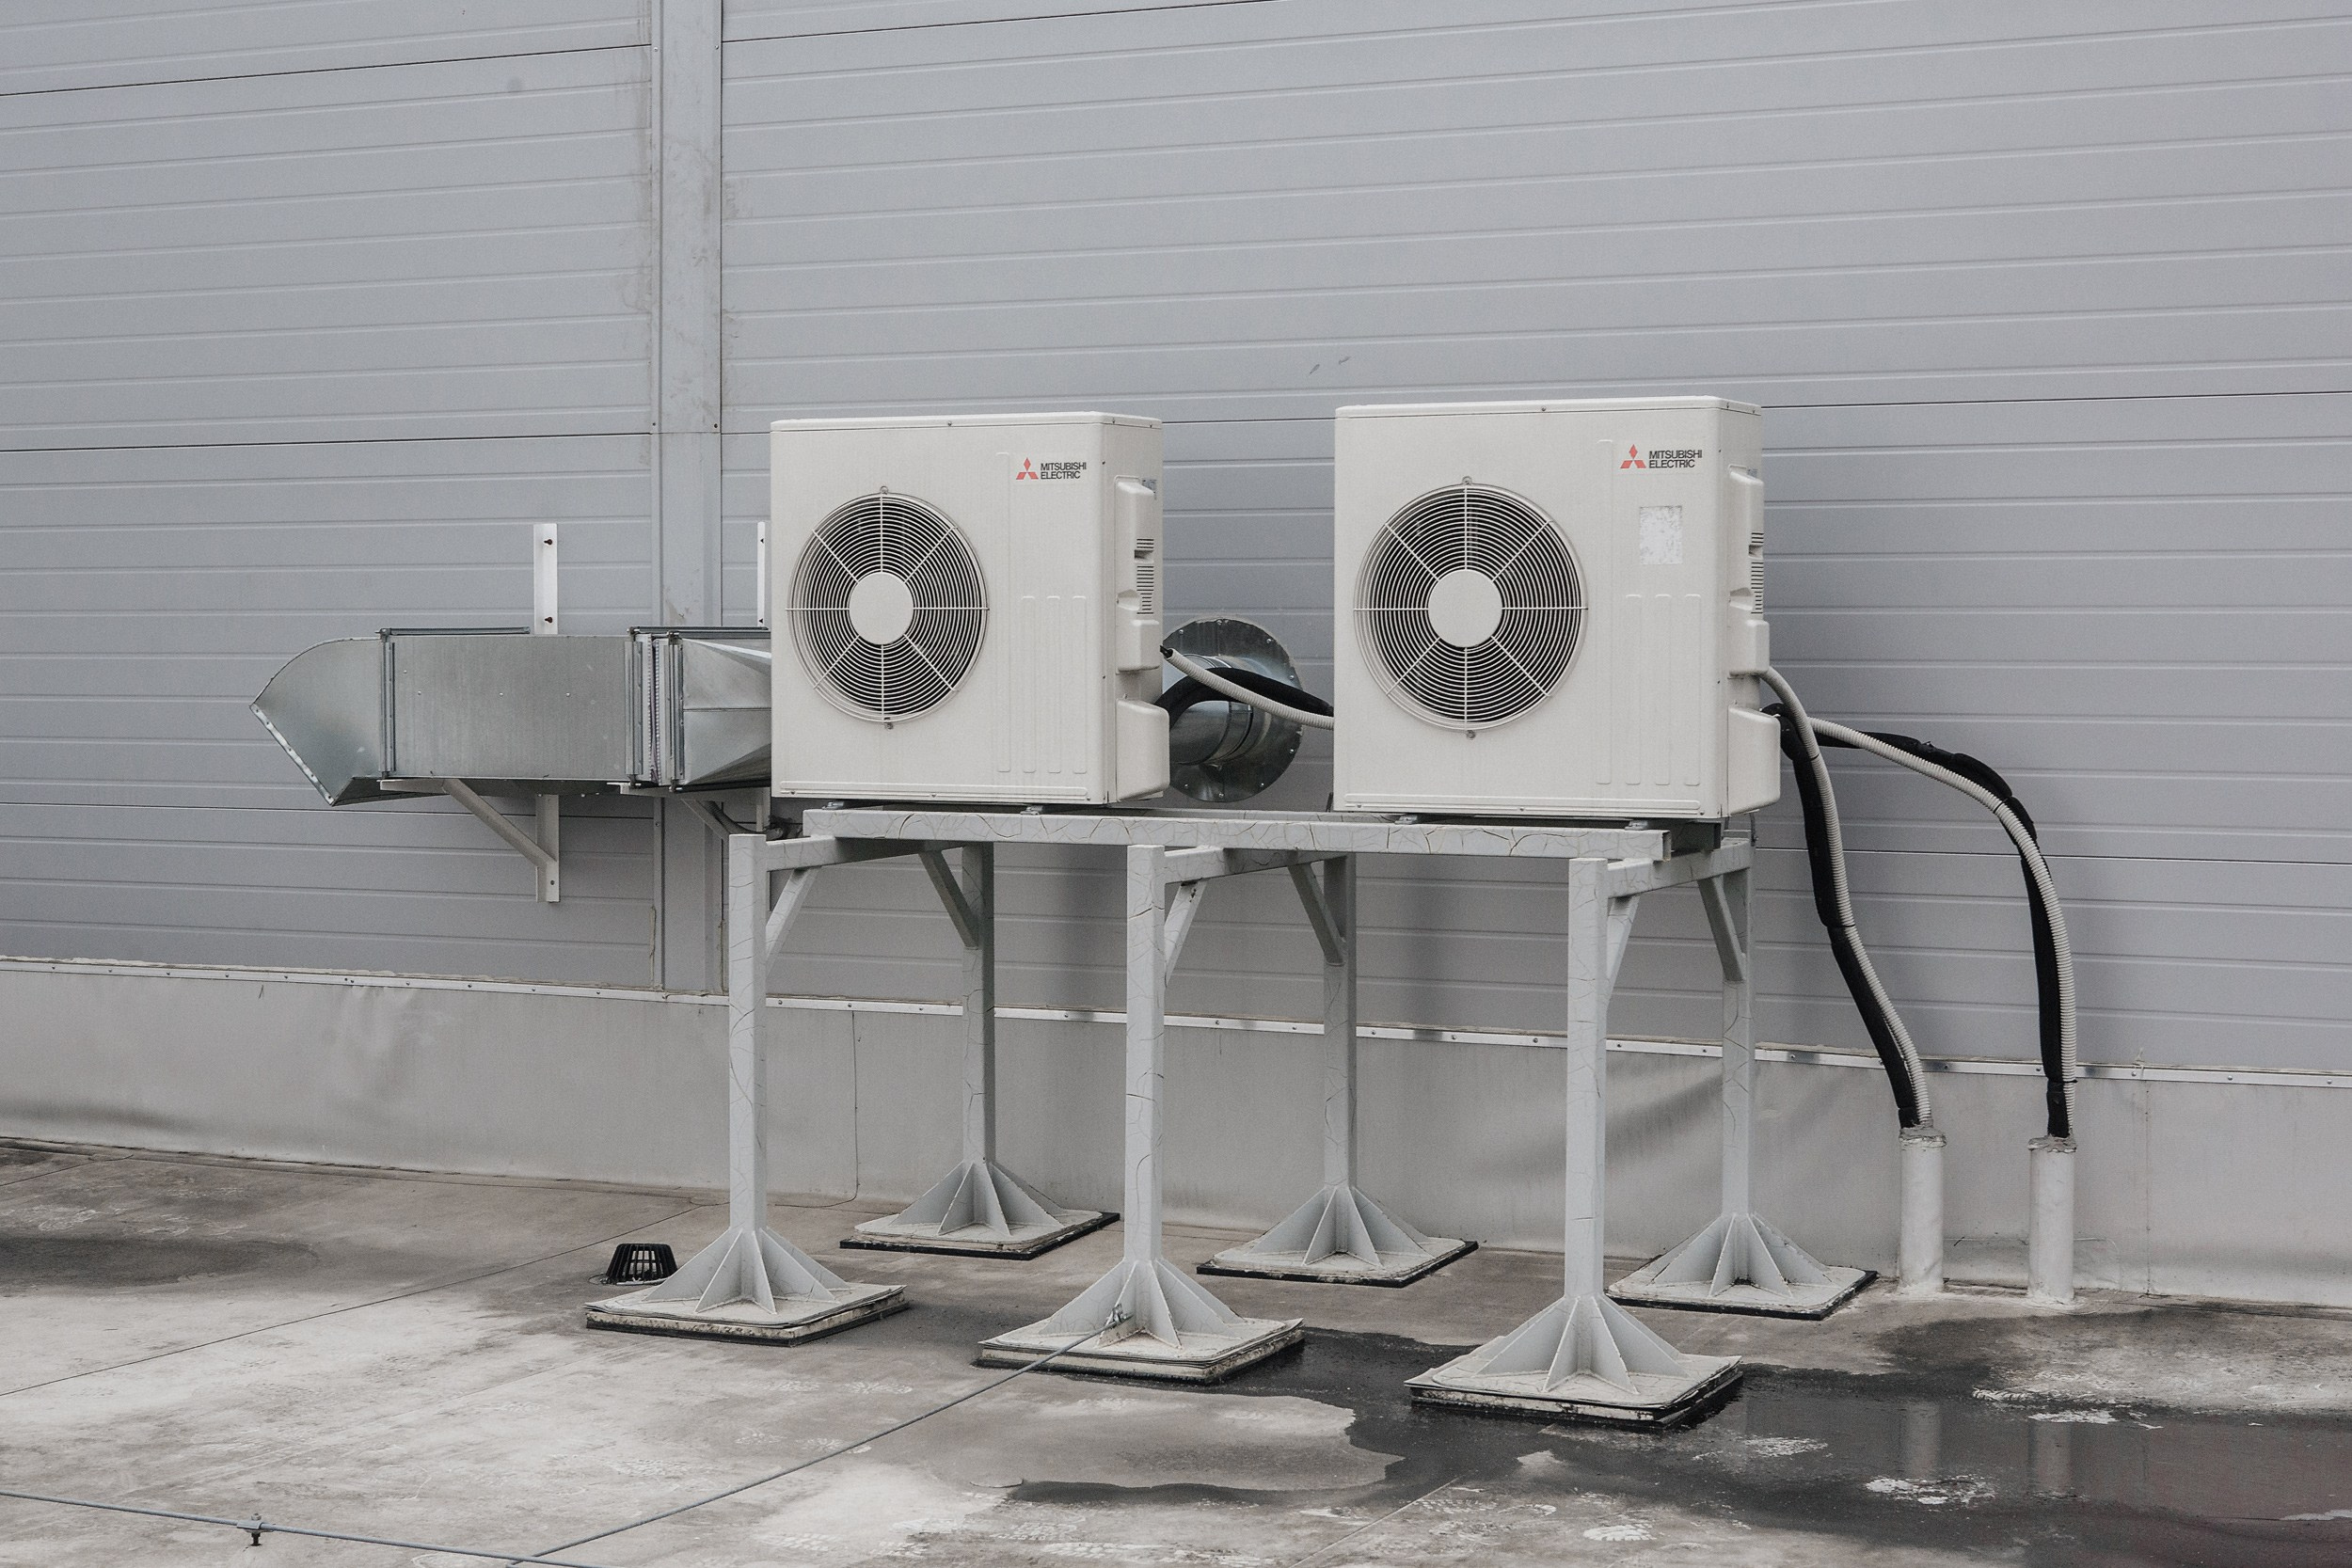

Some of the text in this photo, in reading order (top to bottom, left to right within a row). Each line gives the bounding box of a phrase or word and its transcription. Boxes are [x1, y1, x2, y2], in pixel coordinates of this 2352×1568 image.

[1648, 450, 1702, 459] MITSUBISHI
[1041, 462, 1087, 470] MITSUBISHI
[1648, 459, 1695, 468] ELECTRIC
[1041, 470, 1081, 479] ELECTRIC
